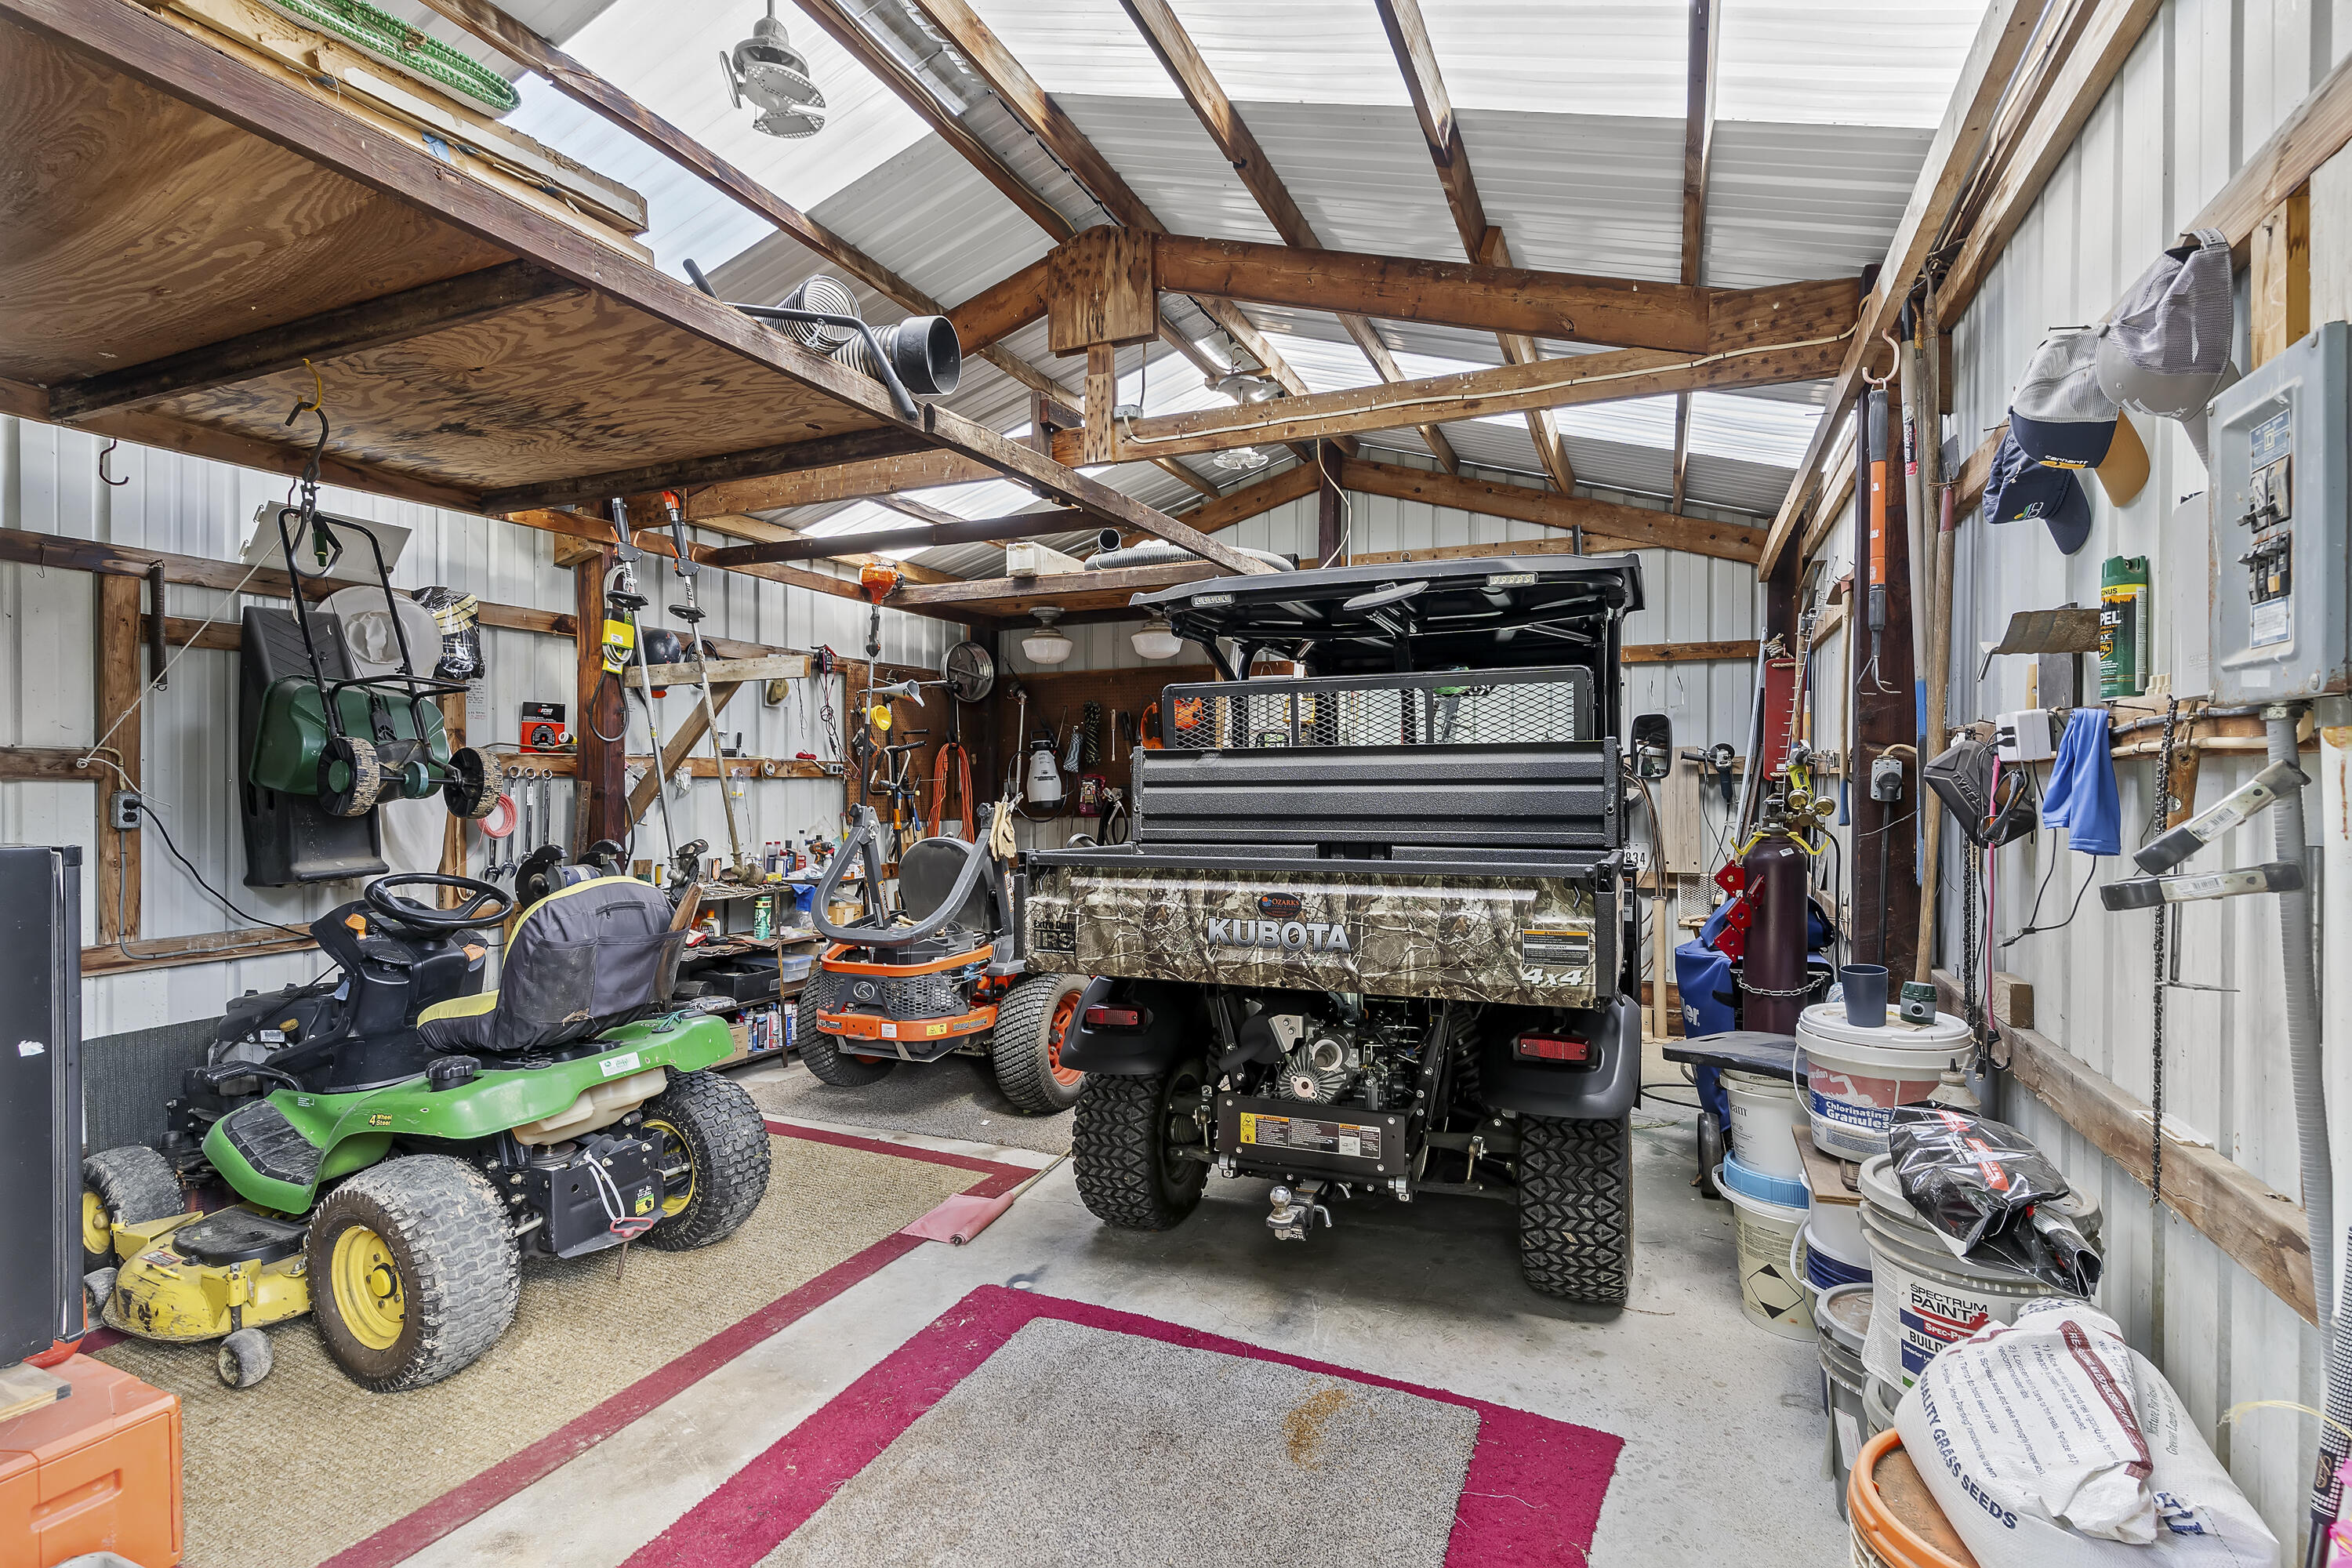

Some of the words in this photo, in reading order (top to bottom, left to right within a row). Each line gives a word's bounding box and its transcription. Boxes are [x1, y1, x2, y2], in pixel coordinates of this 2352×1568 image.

[2100, 587, 2118, 597] ONUS
[1033, 920, 1054, 930] Extra
[1055, 920, 1076, 931] Duty
[1208, 917, 1352, 953] KUBOTA
[1522, 968, 1583, 986] 4x4
[1680, 996, 1700, 1026] ler
[368, 1113, 376, 1127] 4
[1826, 1101, 1889, 1122] Chlorinating
[1826, 1109, 1889, 1129] Granules
[1910, 1283, 1987, 1312] SPECTRUM
[1911, 1294, 1972, 1322] PAINT
[1903, 1344, 1923, 1359] Interior
[2034, 1349, 2050, 1373] thatch
[1958, 1361, 1973, 1381] Tamp
[1979, 1356, 1998, 1383] Spread
[2013, 1353, 2031, 1380] Loosen
[1933, 1428, 1962, 1478] GRASS
[1961, 1474, 2016, 1529] SEEDS
